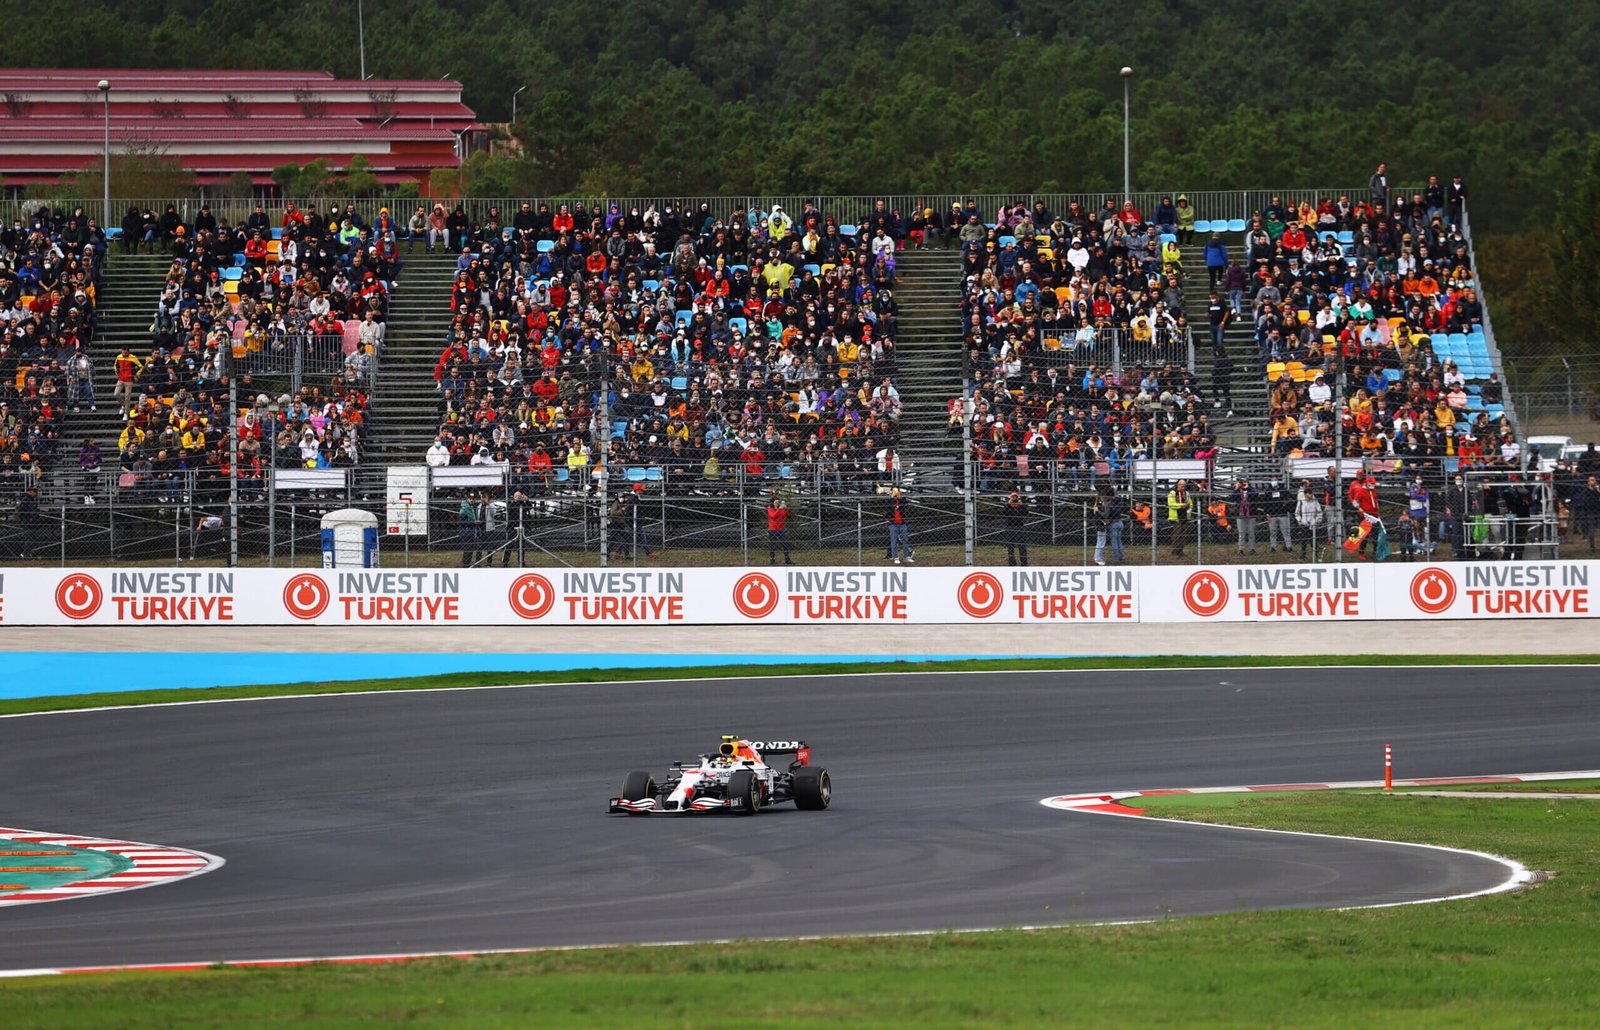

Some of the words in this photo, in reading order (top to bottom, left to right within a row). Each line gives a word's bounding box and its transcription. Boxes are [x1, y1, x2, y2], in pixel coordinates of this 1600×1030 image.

[112, 573, 201, 593] INVEST
[208, 573, 233, 593] IN
[339, 573, 427, 593] INVEST
[434, 573, 458, 593] IN
[564, 573, 651, 593] INVEST
[658, 573, 683, 593] IN
[788, 572, 876, 592] INVEST
[883, 572, 907, 592] IN
[1013, 571, 1100, 592] INVEST
[1107, 571, 1131, 591] IN
[1238, 569, 1326, 590] INVEST
[1334, 568, 1358, 589] IN
[1466, 566, 1555, 587] INVEST
[1563, 565, 1588, 586] IN
[749, 741, 799, 749] ONDA
